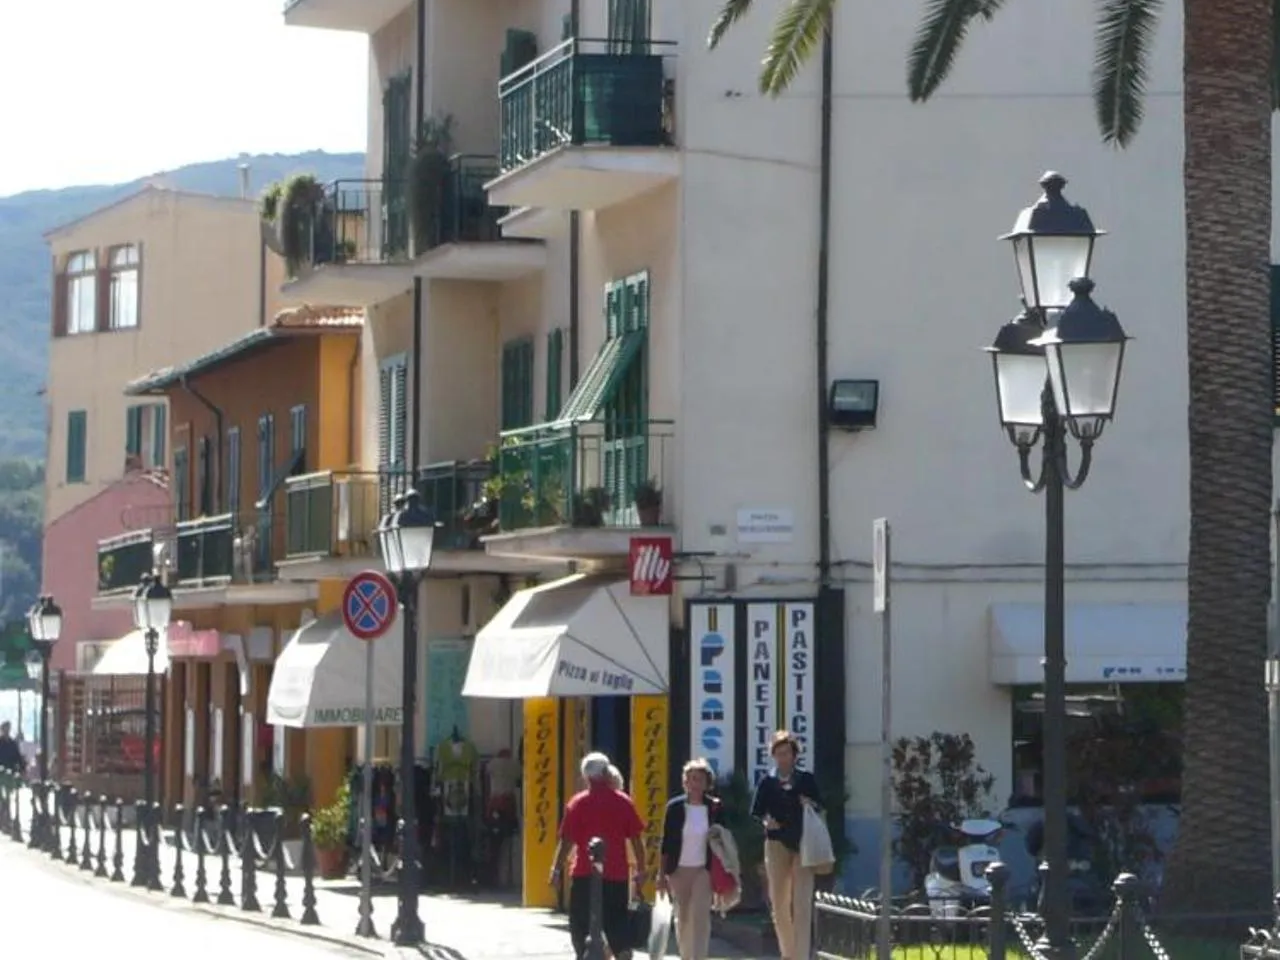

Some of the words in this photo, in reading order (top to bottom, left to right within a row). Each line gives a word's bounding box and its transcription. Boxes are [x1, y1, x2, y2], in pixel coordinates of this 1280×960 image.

[633, 543, 670, 590] illy
[558, 659, 588, 682] Pizza
[313, 706, 403, 723] IMMOBIARE
